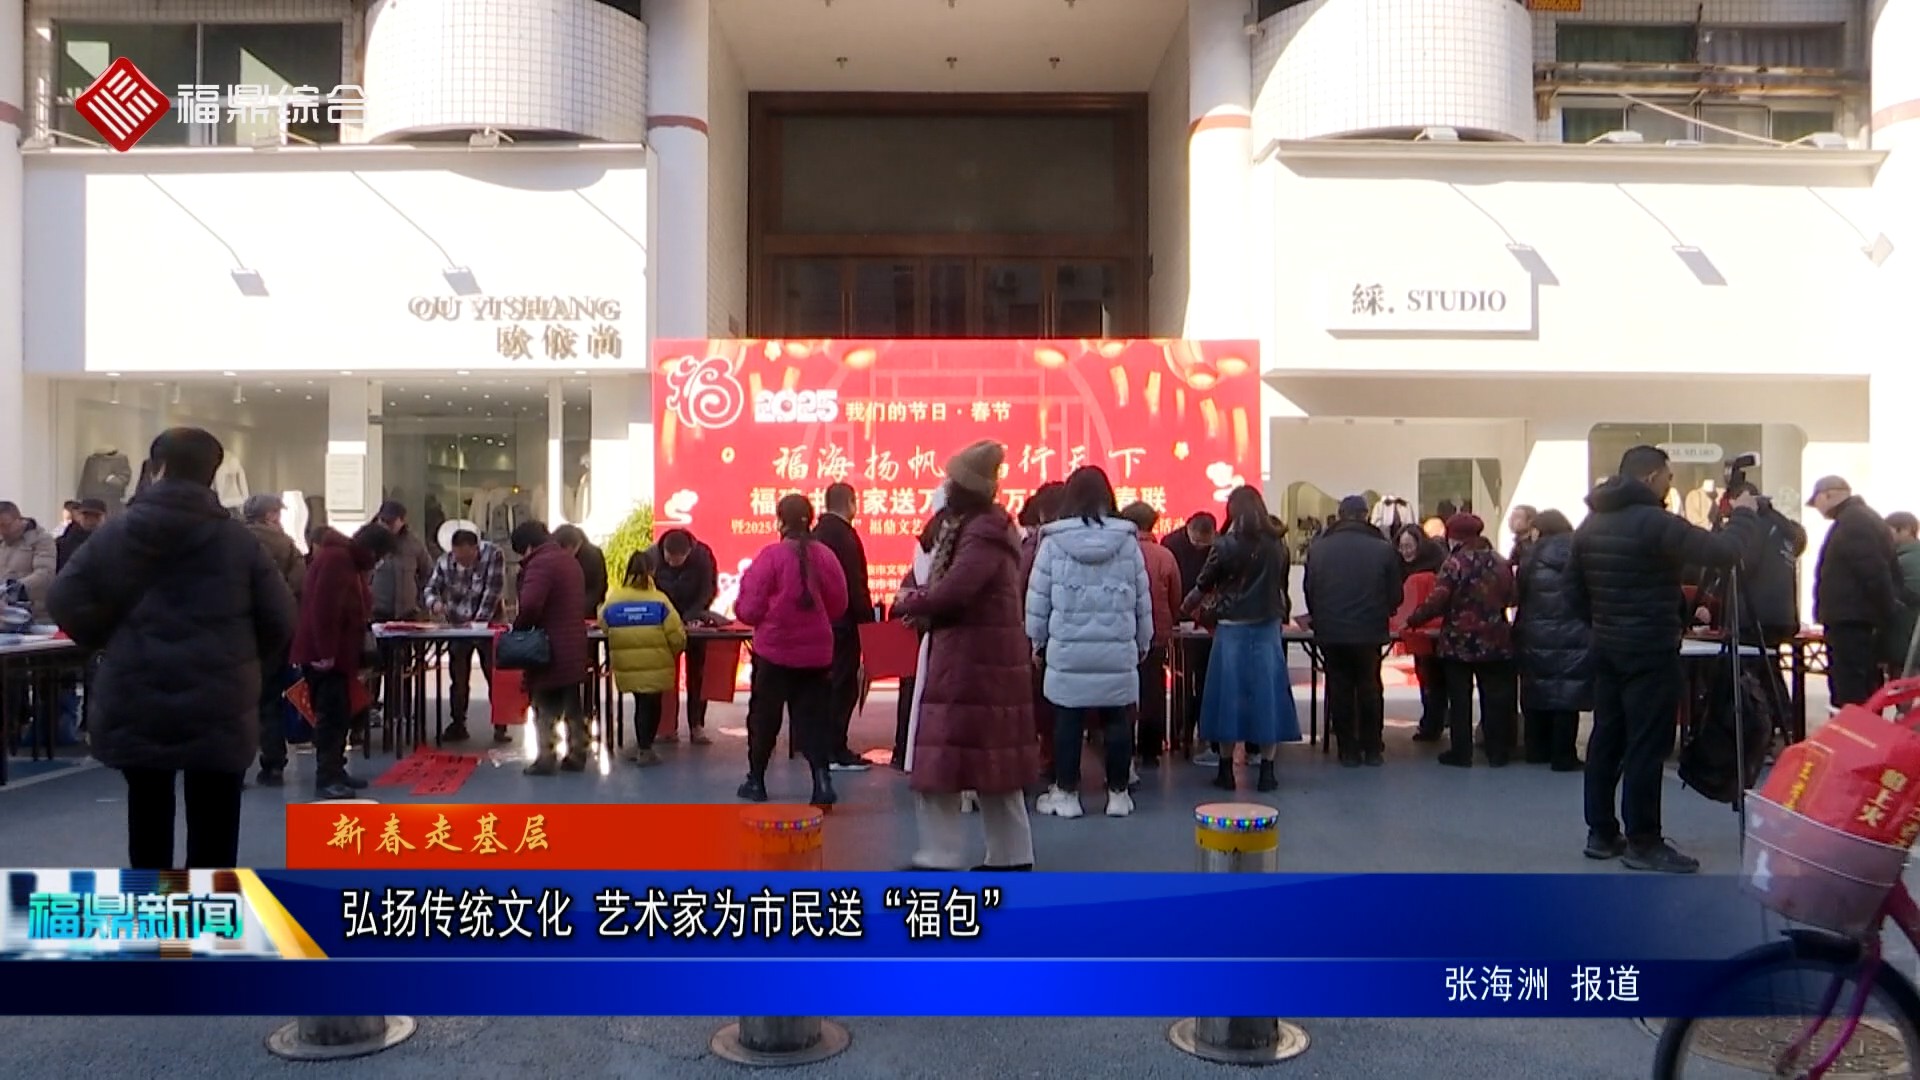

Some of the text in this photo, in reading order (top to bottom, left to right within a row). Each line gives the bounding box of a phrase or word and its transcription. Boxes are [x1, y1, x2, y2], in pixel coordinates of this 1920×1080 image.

[408, 295, 621, 321] OU YISHANG
[1407, 289, 1507, 312] STUDIO
[754, 389, 1011, 423] 2025 我们的节日·春节
[772, 443, 945, 481] 福海扬帆
